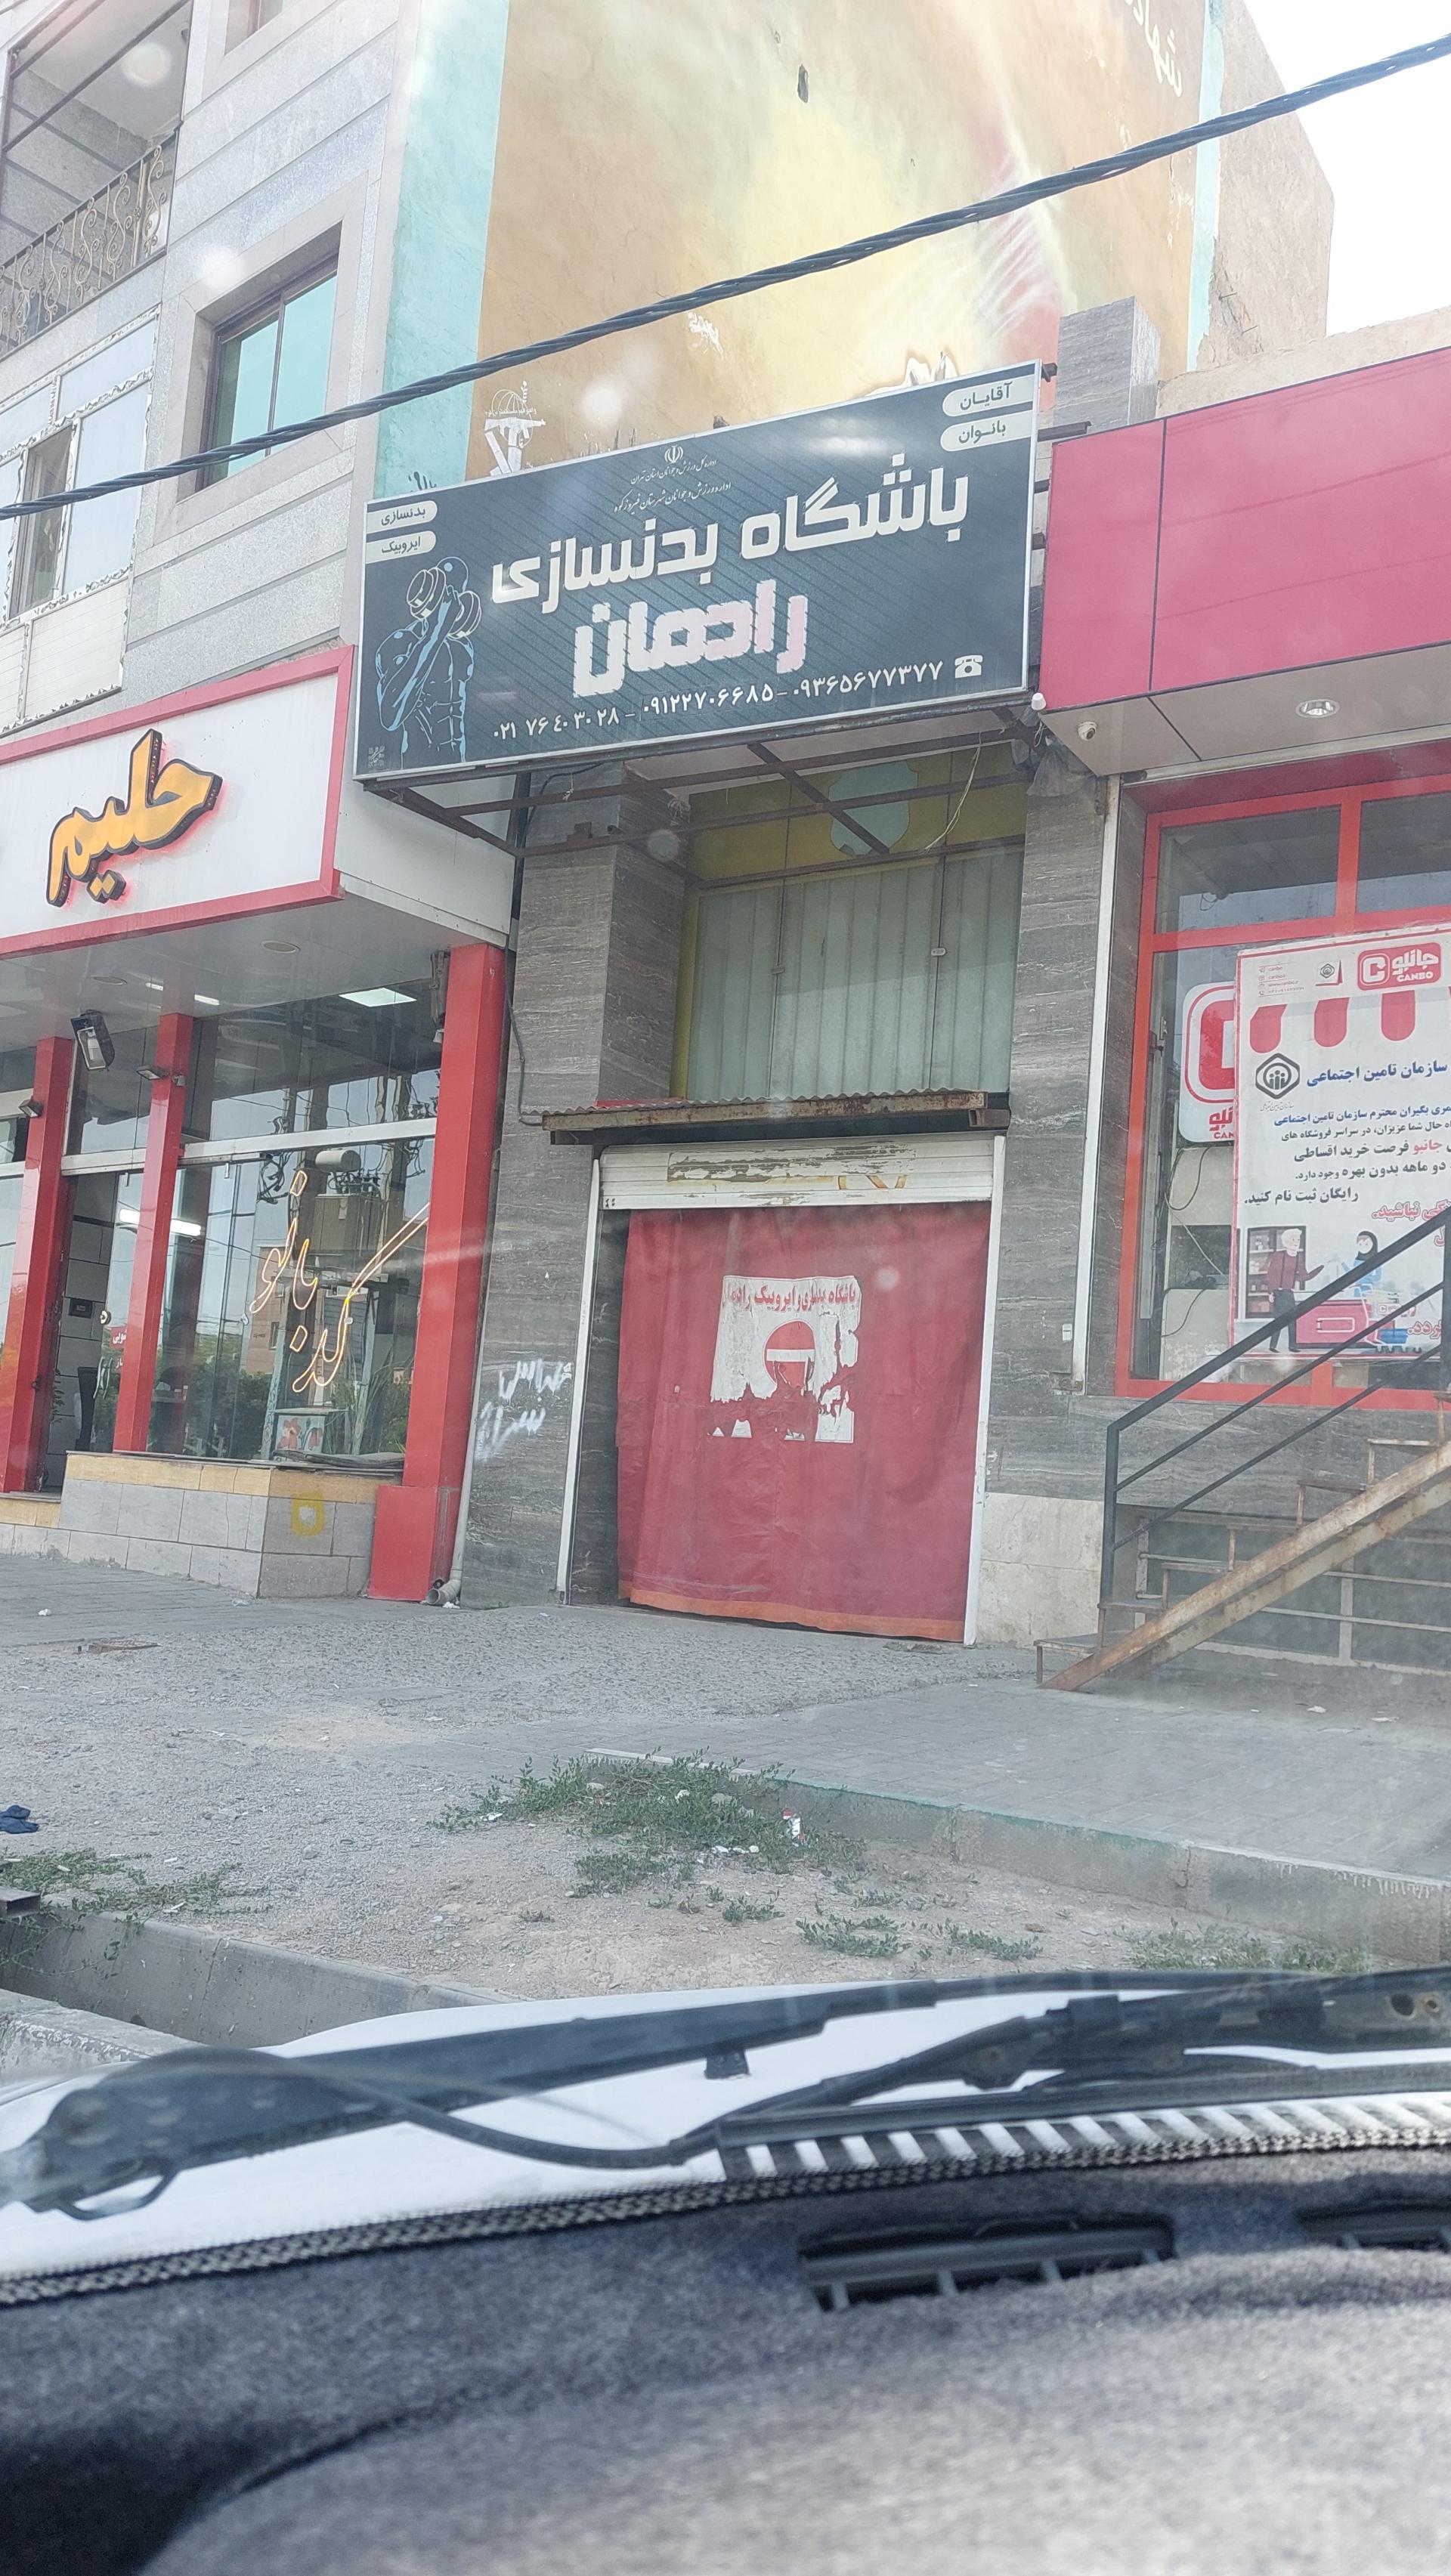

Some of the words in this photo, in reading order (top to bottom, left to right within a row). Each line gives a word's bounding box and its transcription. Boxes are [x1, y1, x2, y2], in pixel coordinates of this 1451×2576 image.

[959, 382, 1011, 410] آقایان
[958, 420, 1006, 444] بانوان
[741, 453, 969, 559] باشگاه
[382, 507, 425, 526] بدنسازی
[382, 537, 421, 555] ایروبیک
[492, 518, 718, 614] بدنسازی
[573, 579, 808, 699] رادمان
[46, 728, 224, 908] حلیم
[1392, 948, 1439, 975] جانبو
[1397, 971, 1434, 982] CANBO
[1307, 1066, 1360, 1087] اجتماعی
[1364, 1063, 1397, 1082] تامین
[1400, 1059, 1448, 1078] سازمان
[1313, 1112, 1334, 1124] تامین
[1336, 1109, 1367, 1122] سازمان
[1370, 1109, 1397, 1119] محترم
[1400, 1105, 1428, 1118] بگیران
[1274, 1114, 1310, 1126] اجتماعی
[1408, 1122, 1423, 1130] شما
[1425, 1121, 1442, 1132] حال
[1336, 1127, 1358, 1140] سراسر
[1361, 1127, 1371, 1136] در
[1295, 1145, 1337, 1161] اقساطی
[1341, 1143, 1369, 1158] خرید
[1374, 1140, 1409, 1156] فرصت
[1414, 1139, 1442, 1155] جانبو
[1319, 1170, 1339, 1180] وجود
[1341, 1165, 1366, 1180] بهره
[1369, 1164, 1399, 1178] بدون
[1403, 1161, 1428, 1173] ماهه
[1431, 1161, 1446, 1175] دو
[1295, 1170, 1316, 1181] دارد.
[1244, 1190, 1271, 1205] کنید.
[1275, 1189, 1292, 1205] نام
[1295, 1187, 1316, 1204] ثبت
[1320, 1186, 1358, 1204] رایگان
[828, 1282, 855, 1310] باشگاه
